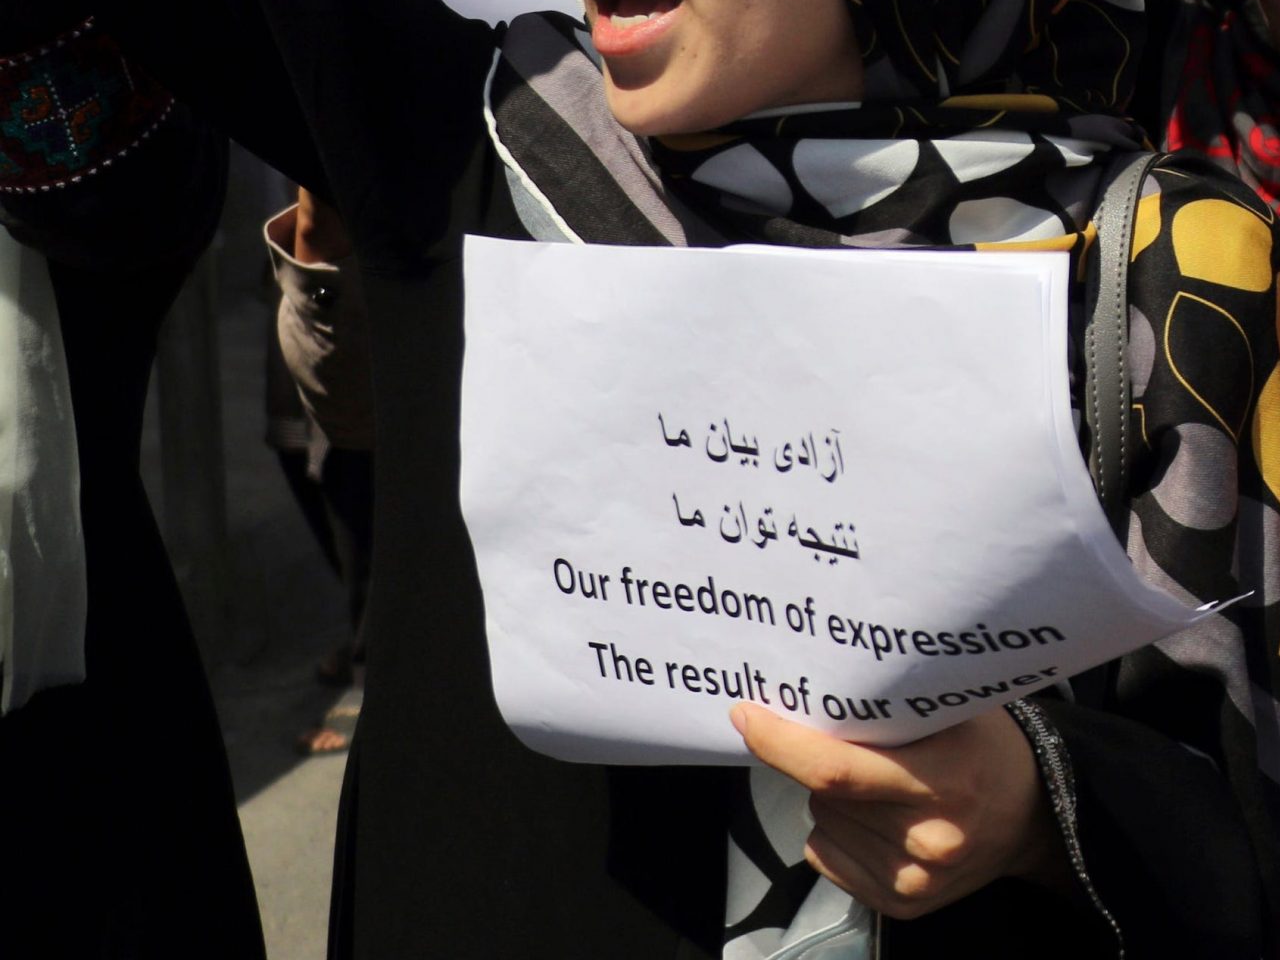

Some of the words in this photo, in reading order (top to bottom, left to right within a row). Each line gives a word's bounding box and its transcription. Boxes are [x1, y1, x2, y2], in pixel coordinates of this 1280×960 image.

[657, 412, 692, 448] ما
[705, 418, 760, 468] بیان
[774, 428, 844, 484] آزادی
[672, 493, 706, 528] ما
[719, 501, 779, 550] توان
[787, 513, 860, 565] نتیجه
[553, 557, 611, 602] Our
[619, 566, 776, 626] freedom
[785, 596, 816, 637] of
[827, 614, 1066, 662] expression
[587, 641, 655, 686] The
[665, 661, 770, 705] result
[778, 676, 811, 716] of
[821, 693, 892, 721] our
[905, 665, 1059, 718] power
